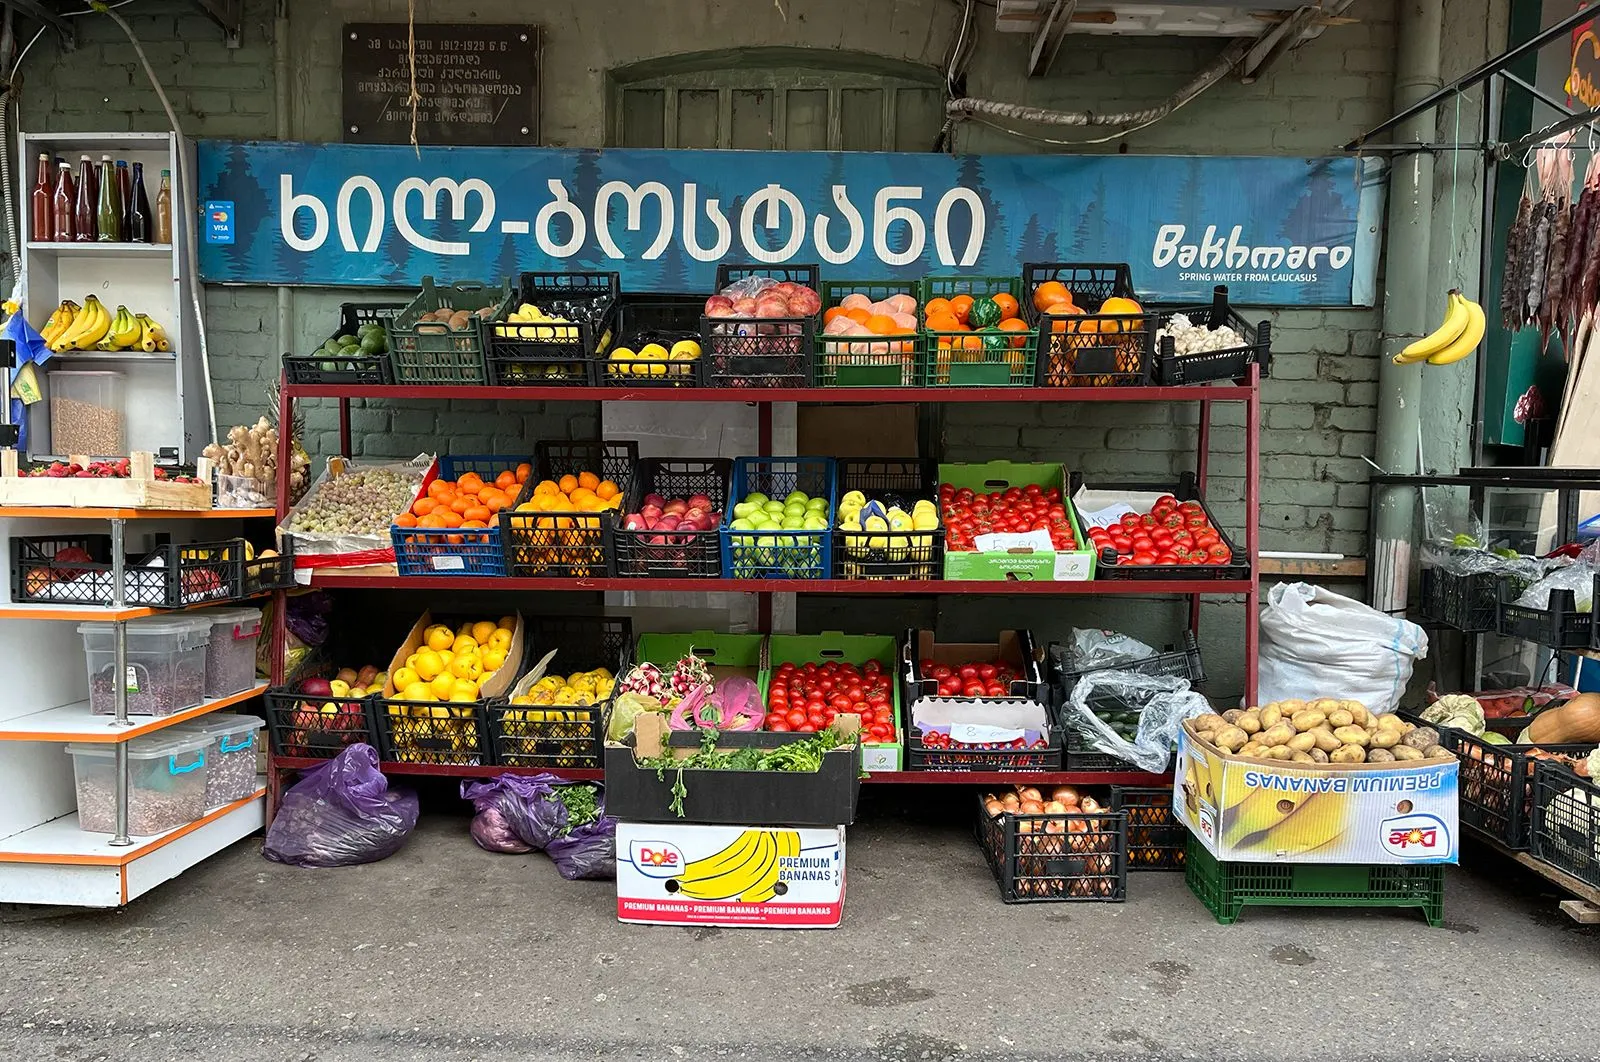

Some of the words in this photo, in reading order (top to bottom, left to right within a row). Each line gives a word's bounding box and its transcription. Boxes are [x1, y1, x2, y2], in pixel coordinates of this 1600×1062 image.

[388, 39, 433, 50] სახში
[440, 40, 485, 51] 1912-1929
[378, 66, 434, 79] ქართლი
[358, 81, 436, 93] მოყვარუთა
[1152, 224, 1352, 270] Bakhmaro
[1179, 272, 1211, 282] SPRING
[1213, 273, 1243, 282] WATER
[1244, 273, 1270, 283] FROM
[1271, 273, 1318, 283] CAUCASUS
[1245, 772, 1347, 793] BANANAS
[1352, 771, 1440, 793] PREMIUM
[1389, 829, 1437, 848] Dole
[640, 848, 679, 864] Dole
[779, 857, 830, 868] PREMIUM
[779, 870, 831, 881] BANANAS
[624, 902, 656, 911] PREMIUM
[656, 903, 689, 913] BANANAS
[693, 905, 726, 914] PREMIUM
[726, 905, 760, 915] BANANAS
[763, 906, 797, 915] PREMIUM
[797, 907, 831, 915] BANANAS
